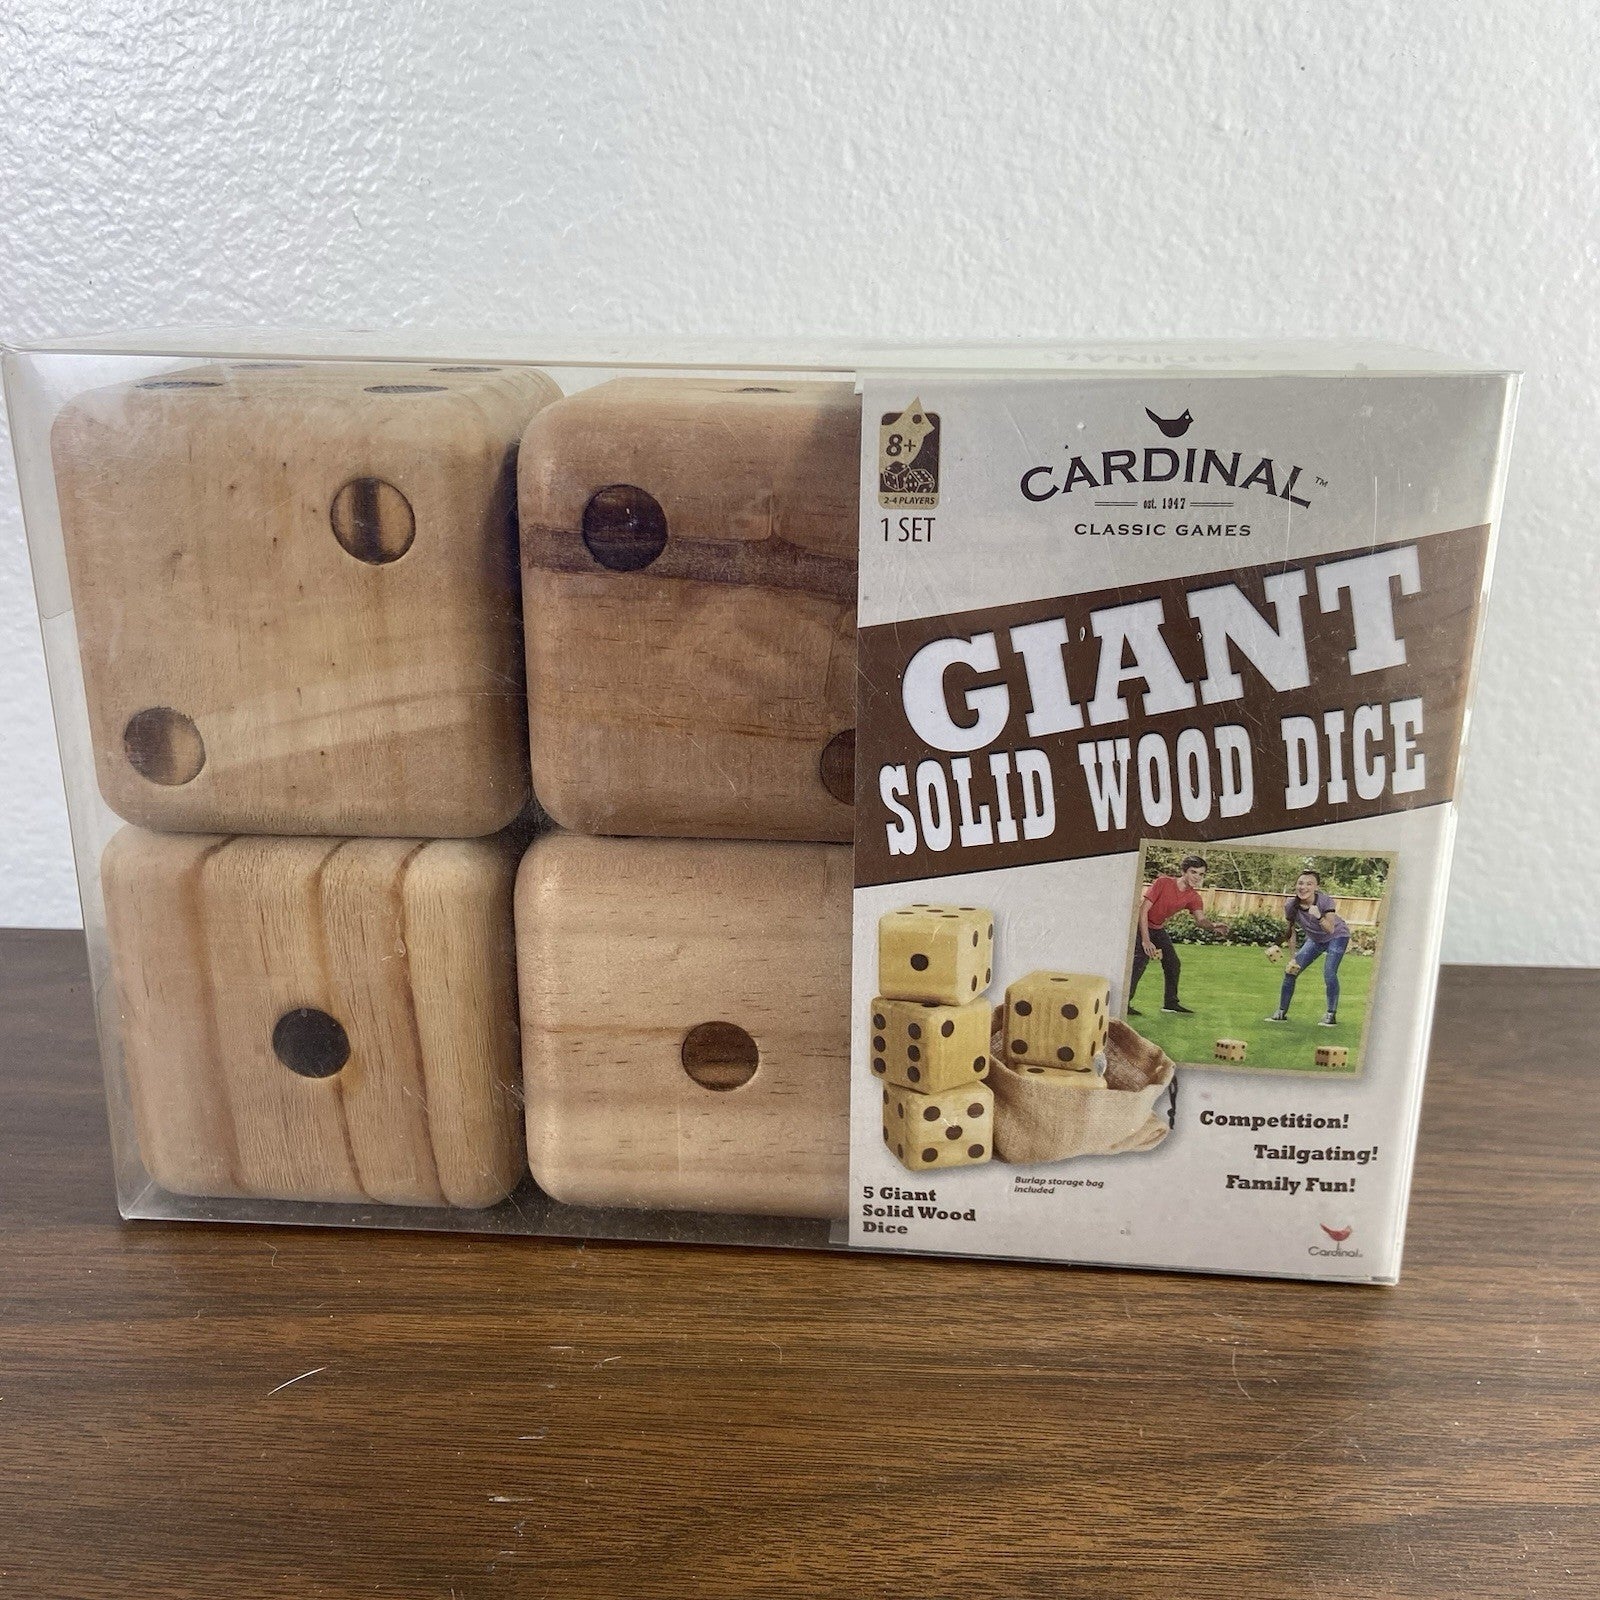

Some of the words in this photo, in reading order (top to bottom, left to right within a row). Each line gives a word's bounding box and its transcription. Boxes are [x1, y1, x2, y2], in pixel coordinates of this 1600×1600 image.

[886, 433, 917, 457] 8+
[1019, 447, 1312, 510] CARDINAL
[883, 496, 898, 505] 2-4
[899, 496, 936, 505] PLAYERS
[1162, 497, 1187, 510] 1947
[880, 517, 889, 542] 1
[898, 516, 937, 543] SET
[1074, 523, 1167, 537] CLASSIC
[1175, 523, 1252, 537] GAMES
[901, 543, 1422, 754] GIANT
[877, 747, 1056, 857] SOLID
[1078, 716, 1253, 832] WOOD
[1280, 696, 1426, 811] DICE
[1199, 1110, 1350, 1132] Competition!
[1253, 1143, 1379, 1165] Tailgating!
[1014, 1175, 1046, 1186] Burlap
[1048, 1178, 1085, 1189] storage
[1085, 1179, 1105, 1189] bag
[1014, 1185, 1056, 1195] included
[1225, 1173, 1301, 1195] Family
[1305, 1177, 1356, 1193] Fun!
[863, 1186, 874, 1199] 5
[879, 1187, 938, 1202] Giant
[862, 1203, 915, 1219] Solid
[918, 1206, 977, 1222] Wood
[862, 1220, 909, 1235] Dice
